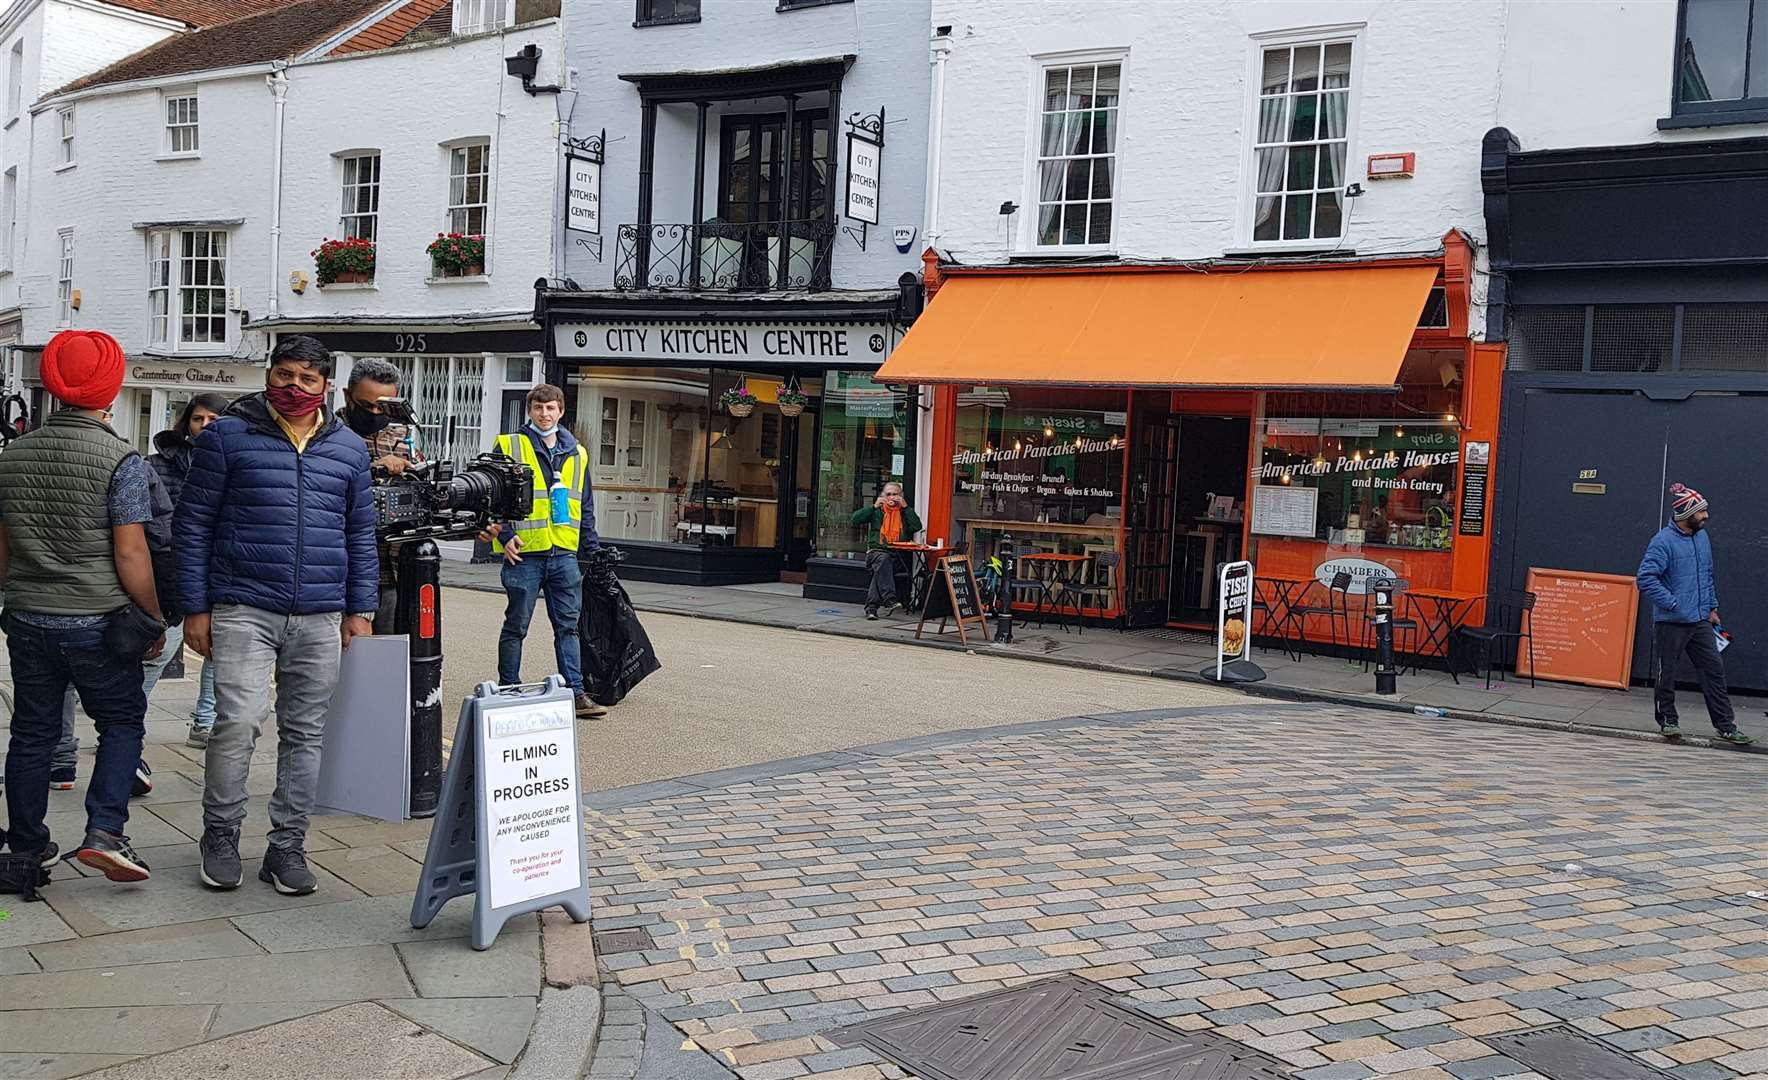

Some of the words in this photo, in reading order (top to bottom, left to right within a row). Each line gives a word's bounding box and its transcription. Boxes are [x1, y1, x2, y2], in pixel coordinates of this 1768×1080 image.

[857, 154, 872, 168] CITY
[576, 172, 592, 183] CITY
[850, 172, 877, 189] KITCHEN
[569, 188, 598, 202] KITCHEN
[852, 193, 874, 208] CENTRE
[571, 206, 596, 219] CENTRE
[895, 229, 910, 237] PPS
[395, 334, 427, 352] 925
[575, 334, 587, 345] 58
[605, 329, 648, 353] CITY
[661, 330, 748, 355] KITCHEN
[763, 330, 848, 356] CENTRE
[869, 337, 883, 350] 58
[132, 366, 182, 384] Canterbury
[185, 368, 213, 382] Glass
[961, 448, 1020, 465] American
[1023, 440, 1076, 459] Pancake
[1262, 459, 1331, 478] American
[1335, 453, 1400, 473] Pancake
[1403, 449, 1451, 467] House
[1003, 472, 1034, 483] Breakfast
[1041, 474, 1065, 483] Brunch
[1352, 477, 1371, 488] and
[1374, 477, 1408, 490] British
[1410, 479, 1443, 494] Eatery
[961, 481, 985, 492] Burgers
[992, 483, 1005, 491] Fish
[1006, 484, 1011, 492] &
[1012, 484, 1029, 494] Chips
[1036, 485, 1056, 496] Vegan
[1083, 488, 1089, 496] &
[1090, 488, 1113, 497] Shakes
[1324, 564, 1387, 577] CHAMBERS
[1225, 576, 1248, 597] FISH
[1229, 595, 1247, 608] CHIPS
[503, 743, 558, 763] FILMING
[525, 765, 538, 780] IN
[493, 777, 569, 802] PROGRESS
[498, 816, 511, 825] WE
[512, 808, 554, 823] APOLOGISE
[555, 805, 570, 814] FOR
[496, 827, 512, 836] ANY
[513, 815, 571, 833] INCONVENIENCE
[520, 830, 550, 842] CAUSED
[510, 857, 528, 866] Thank
[529, 855, 540, 863] you
[551, 849, 564, 858] your
